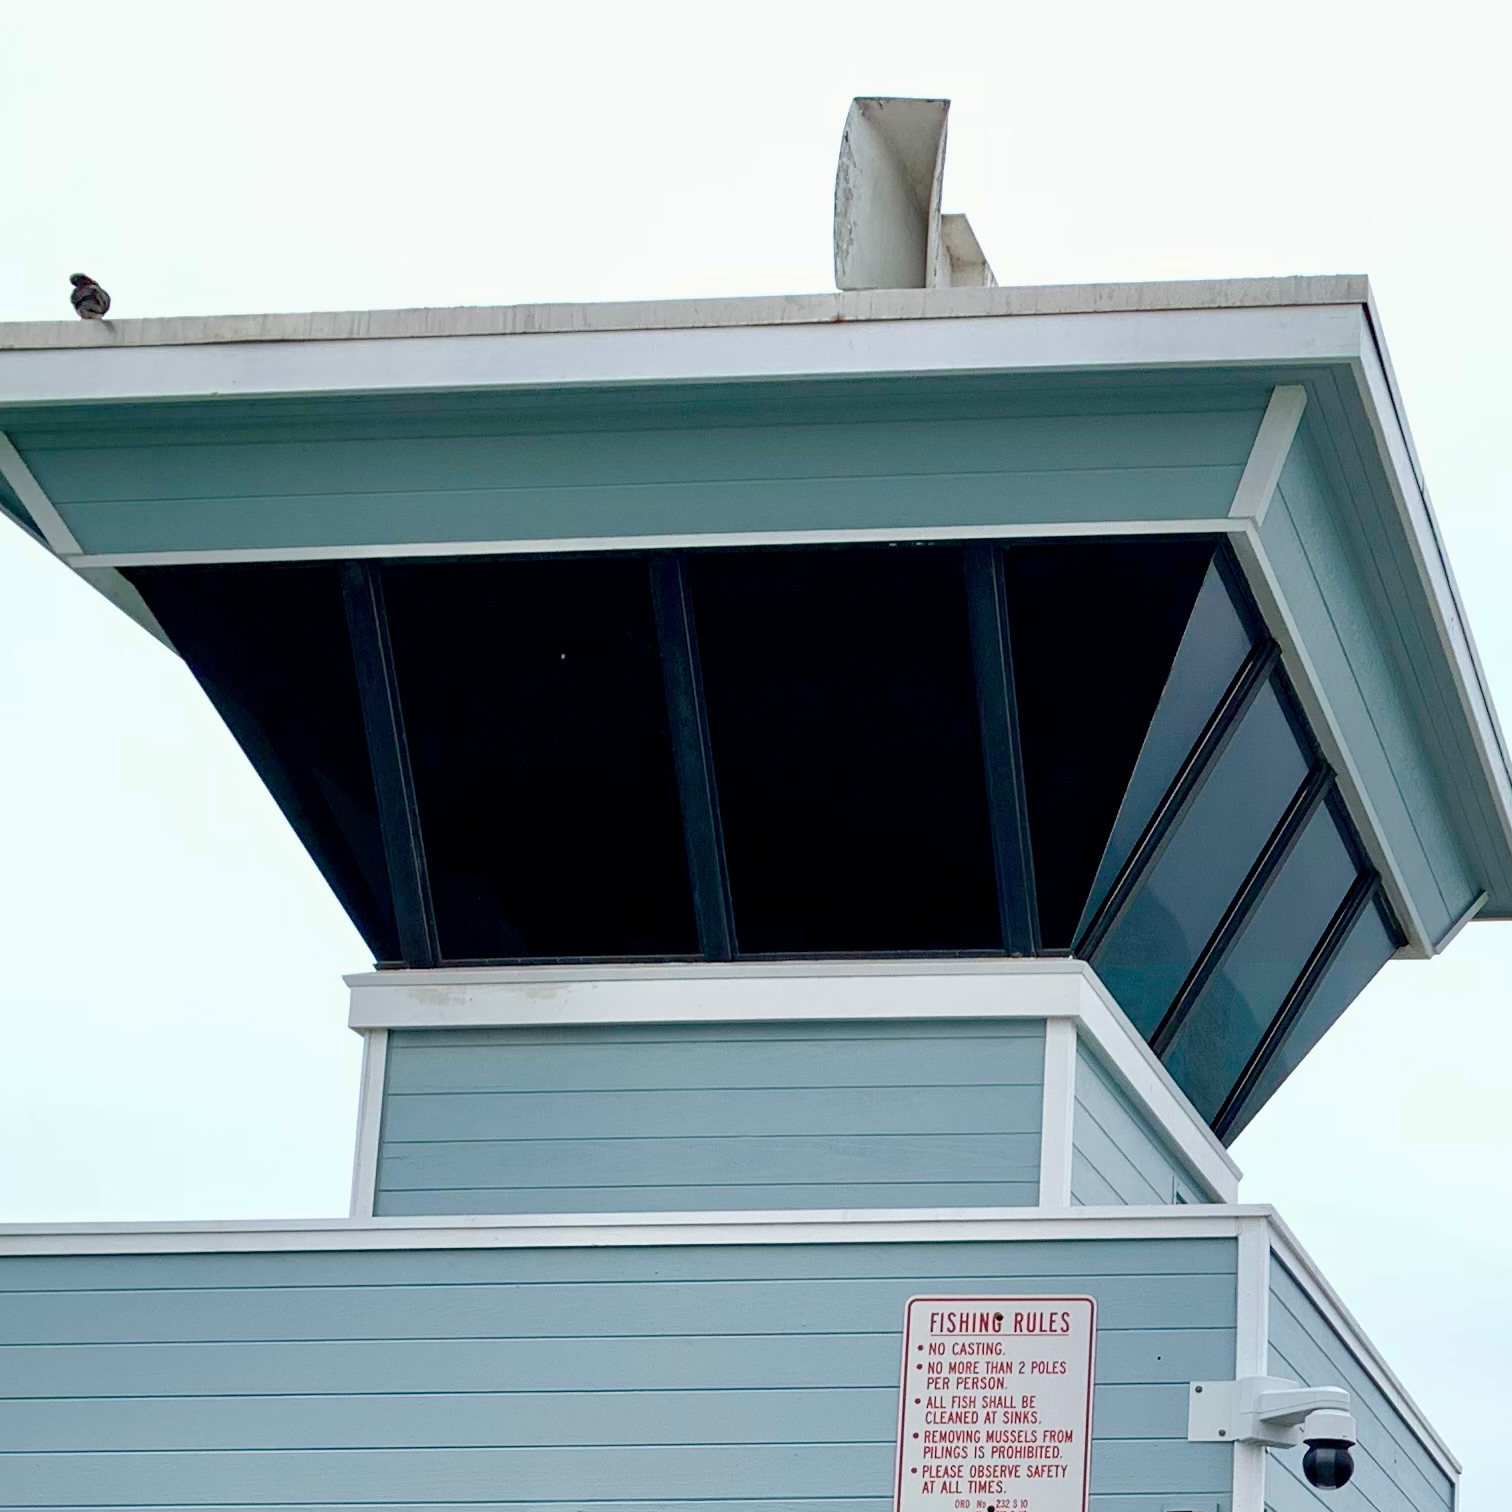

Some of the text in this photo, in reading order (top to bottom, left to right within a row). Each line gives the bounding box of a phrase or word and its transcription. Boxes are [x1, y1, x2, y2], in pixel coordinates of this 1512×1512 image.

[930, 1312, 1070, 1333] FISHING RULES
[928, 1342, 1006, 1356] NO CASTING.
[927, 1361, 1066, 1375] NO MORE THAN 2 POLES
[926, 1377, 1008, 1390] PER PERSON.
[926, 1396, 1036, 1409] ALL FISH SHALL BE
[925, 1411, 1042, 1424] CLEANED AT SINKS.
[923, 1430, 1073, 1444] REMOVING MUSSELS FROM
[923, 1446, 1063, 1459] PILINGS IS PROHIBITED.
[922, 1465, 1068, 1478] PLEASE OBSERVE SAFETY
[922, 1481, 1007, 1494] AT ALL TIMES.
[955, 1499, 970, 1509] ORD
[996, 1499, 1010, 1508] 232
[1020, 1499, 1028, 1508] 10
